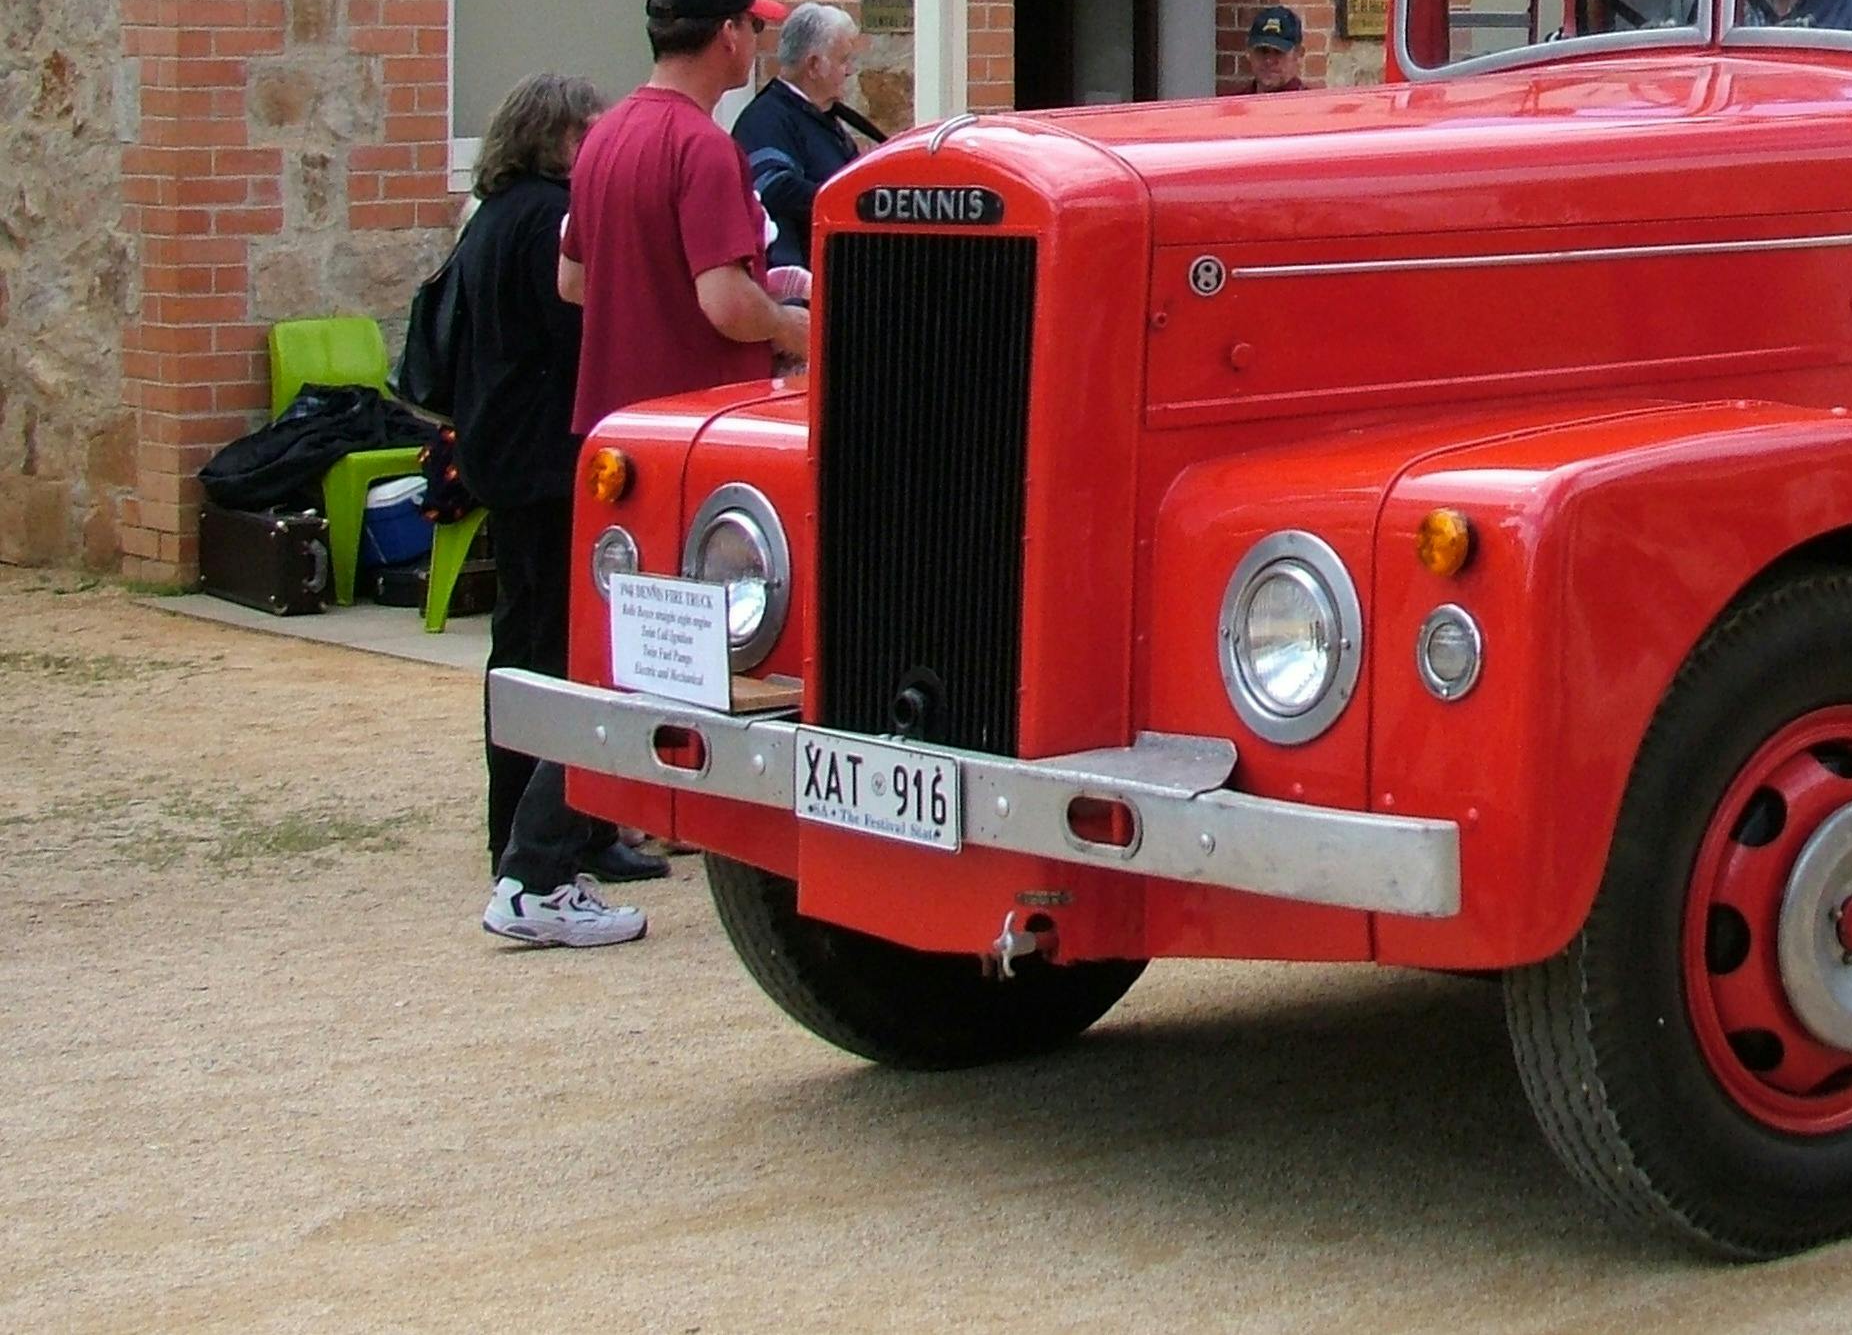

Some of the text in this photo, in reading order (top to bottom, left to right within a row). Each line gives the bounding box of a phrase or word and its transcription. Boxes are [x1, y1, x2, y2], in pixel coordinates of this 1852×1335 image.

[873, 188, 984, 220] DENNIS
[804, 742, 946, 826] XAT 916
[840, 808, 860, 826] The
[864, 813, 906, 835] Festival
